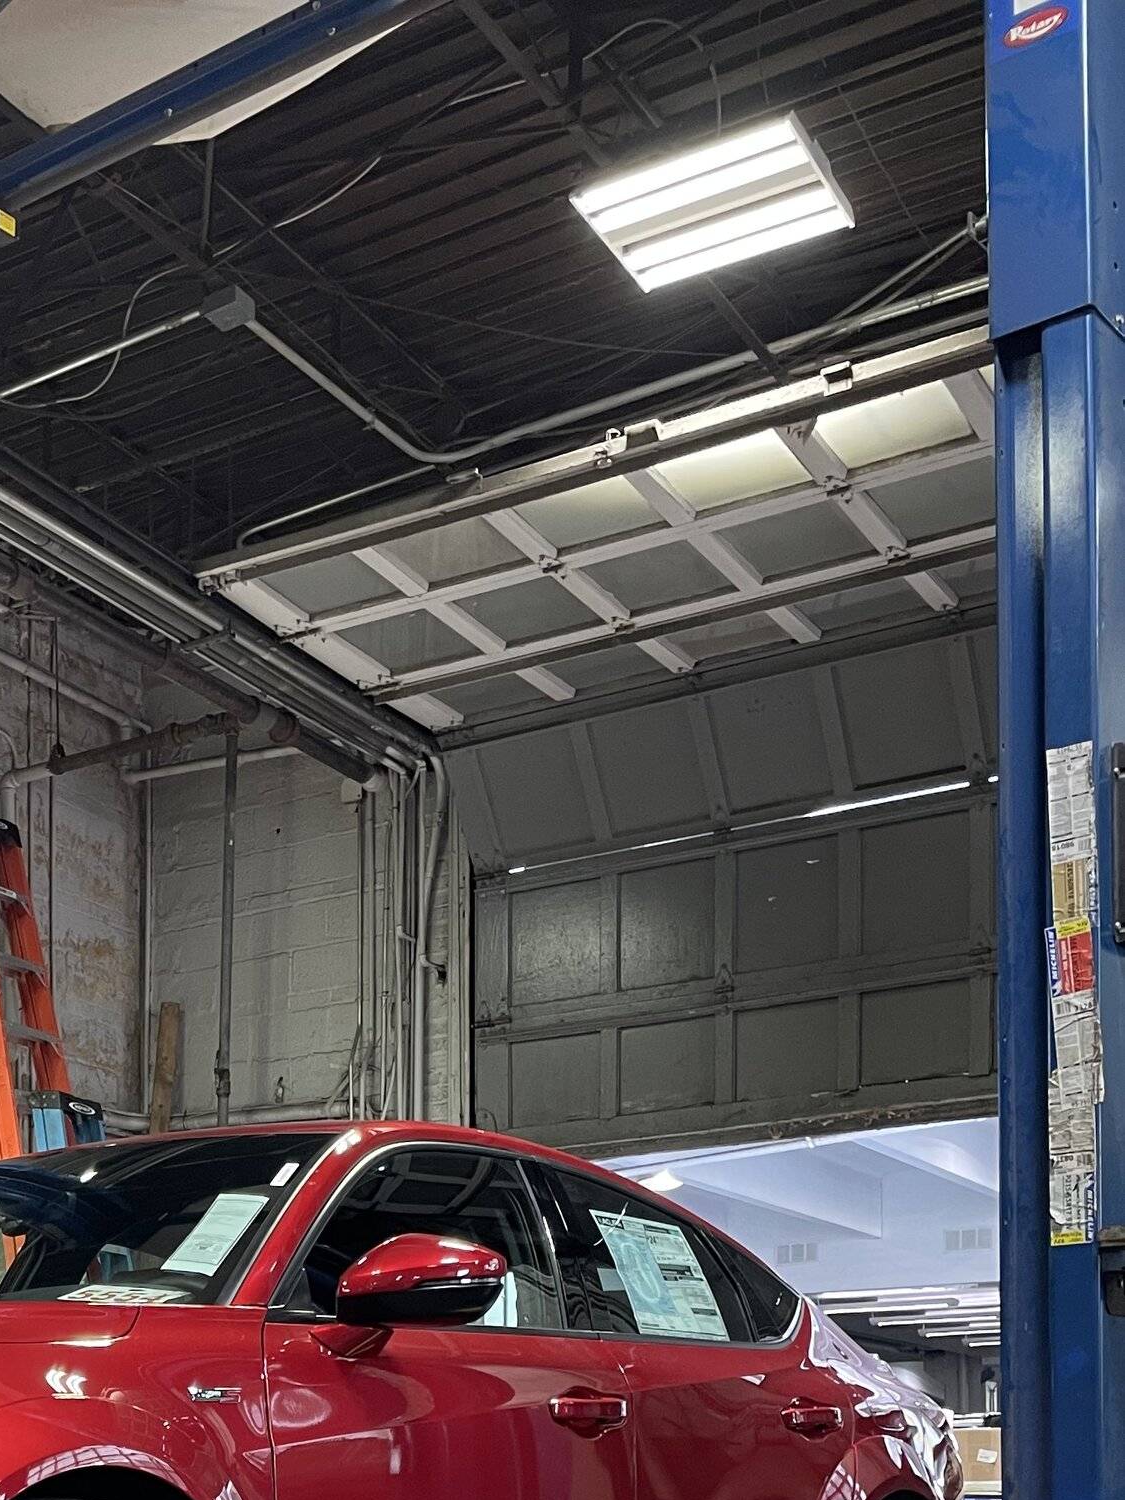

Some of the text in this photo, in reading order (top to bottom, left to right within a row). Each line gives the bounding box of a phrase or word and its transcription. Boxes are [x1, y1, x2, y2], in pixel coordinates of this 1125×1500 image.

[1009, 12, 1062, 42] Rotary
[1047, 931, 1058, 980] MICHELIN
[1086, 1189, 1094, 1240] MICHELIN
